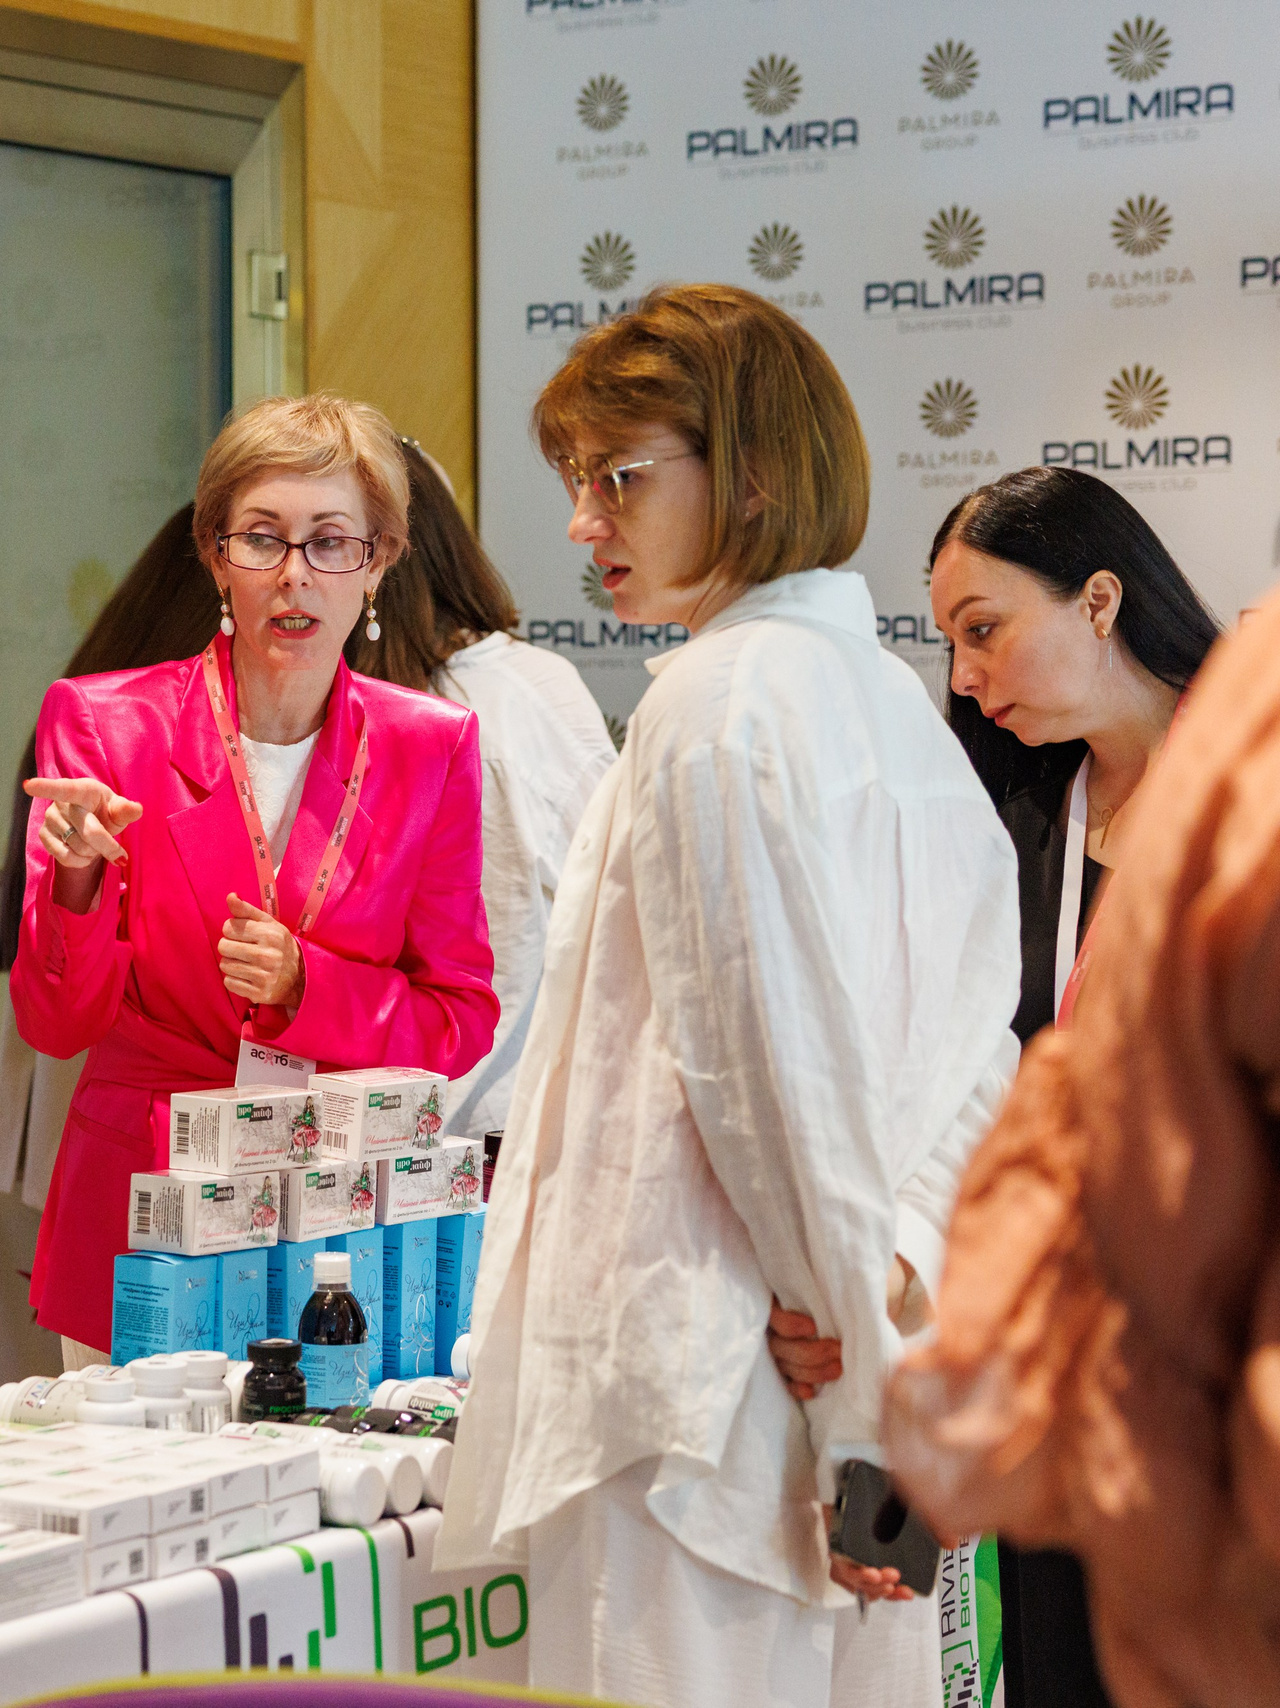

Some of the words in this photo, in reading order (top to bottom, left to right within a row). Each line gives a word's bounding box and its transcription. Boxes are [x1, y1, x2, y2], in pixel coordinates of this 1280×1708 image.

[897, 109, 1000, 134] PALMIRA
[1043, 83, 1235, 129] PALMIRA
[686, 117, 859, 161] PALMIRA
[864, 272, 1045, 313] PALMIRA
[1087, 267, 1197, 291] PALMIRA
[896, 448, 1001, 470] PALMIRA
[1042, 435, 1233, 470] PALMIRA
[528, 619, 690, 647] PALMIRA
[940, 1549, 956, 1638] RIVIE
[413, 1573, 529, 1677] BIO
